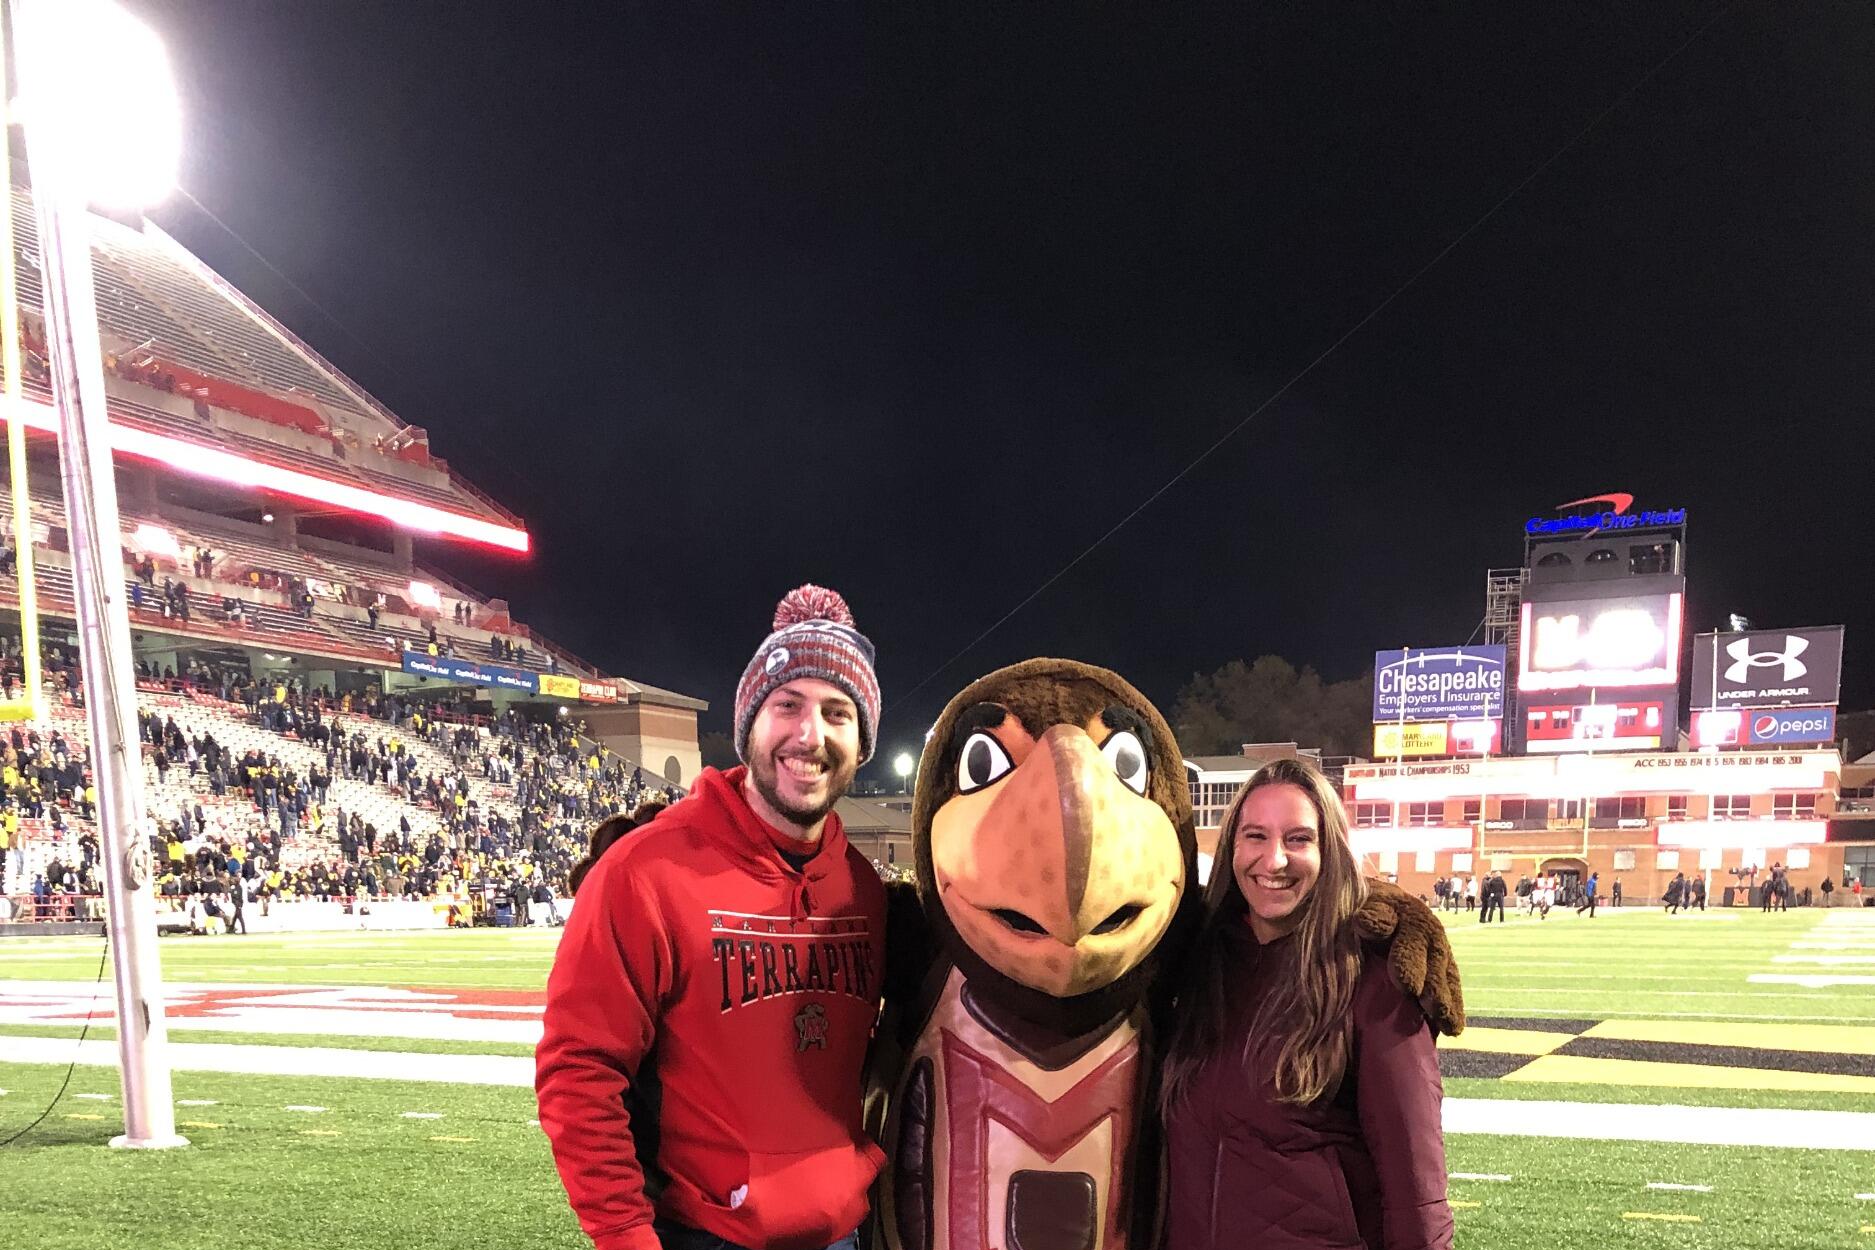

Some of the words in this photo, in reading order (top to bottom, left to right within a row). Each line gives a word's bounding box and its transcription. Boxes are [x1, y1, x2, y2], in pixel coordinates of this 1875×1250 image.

[1640, 508, 1686, 526] Field
[1379, 664, 1502, 702] Chesapeake
[1379, 693, 1438, 706] Employers
[1447, 690, 1501, 702] Insurance
[1718, 690, 1756, 699] UNDER
[1759, 688, 1809, 697] ARMOUR
[1422, 704, 1469, 713] compensation
[1470, 702, 1501, 711] specalist
[1780, 717, 1827, 734] pepsi
[1453, 764, 1470, 774] 1953
[1634, 759, 1655, 768] ACC
